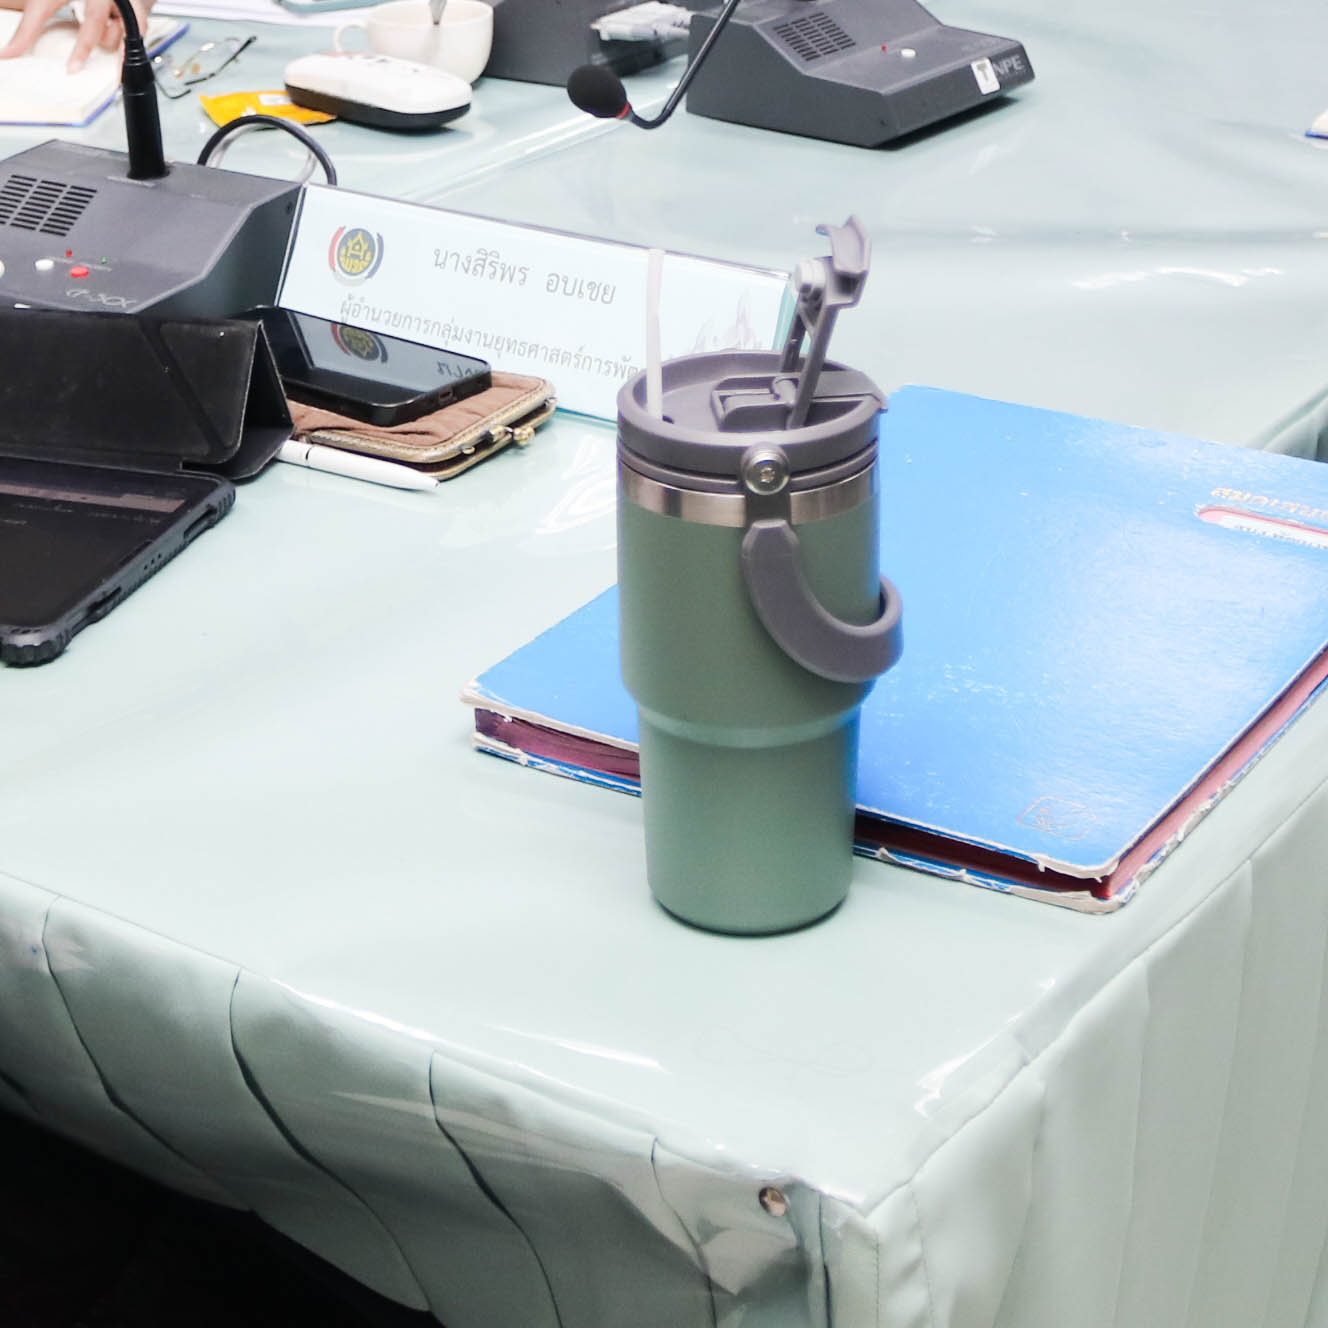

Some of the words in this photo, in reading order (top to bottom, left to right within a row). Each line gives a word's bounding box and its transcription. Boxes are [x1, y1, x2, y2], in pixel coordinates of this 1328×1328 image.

[993, 53, 1025, 79] NPE
[432, 246, 530, 287] นางสิริพร
[544, 270, 617, 305] อบเชย
